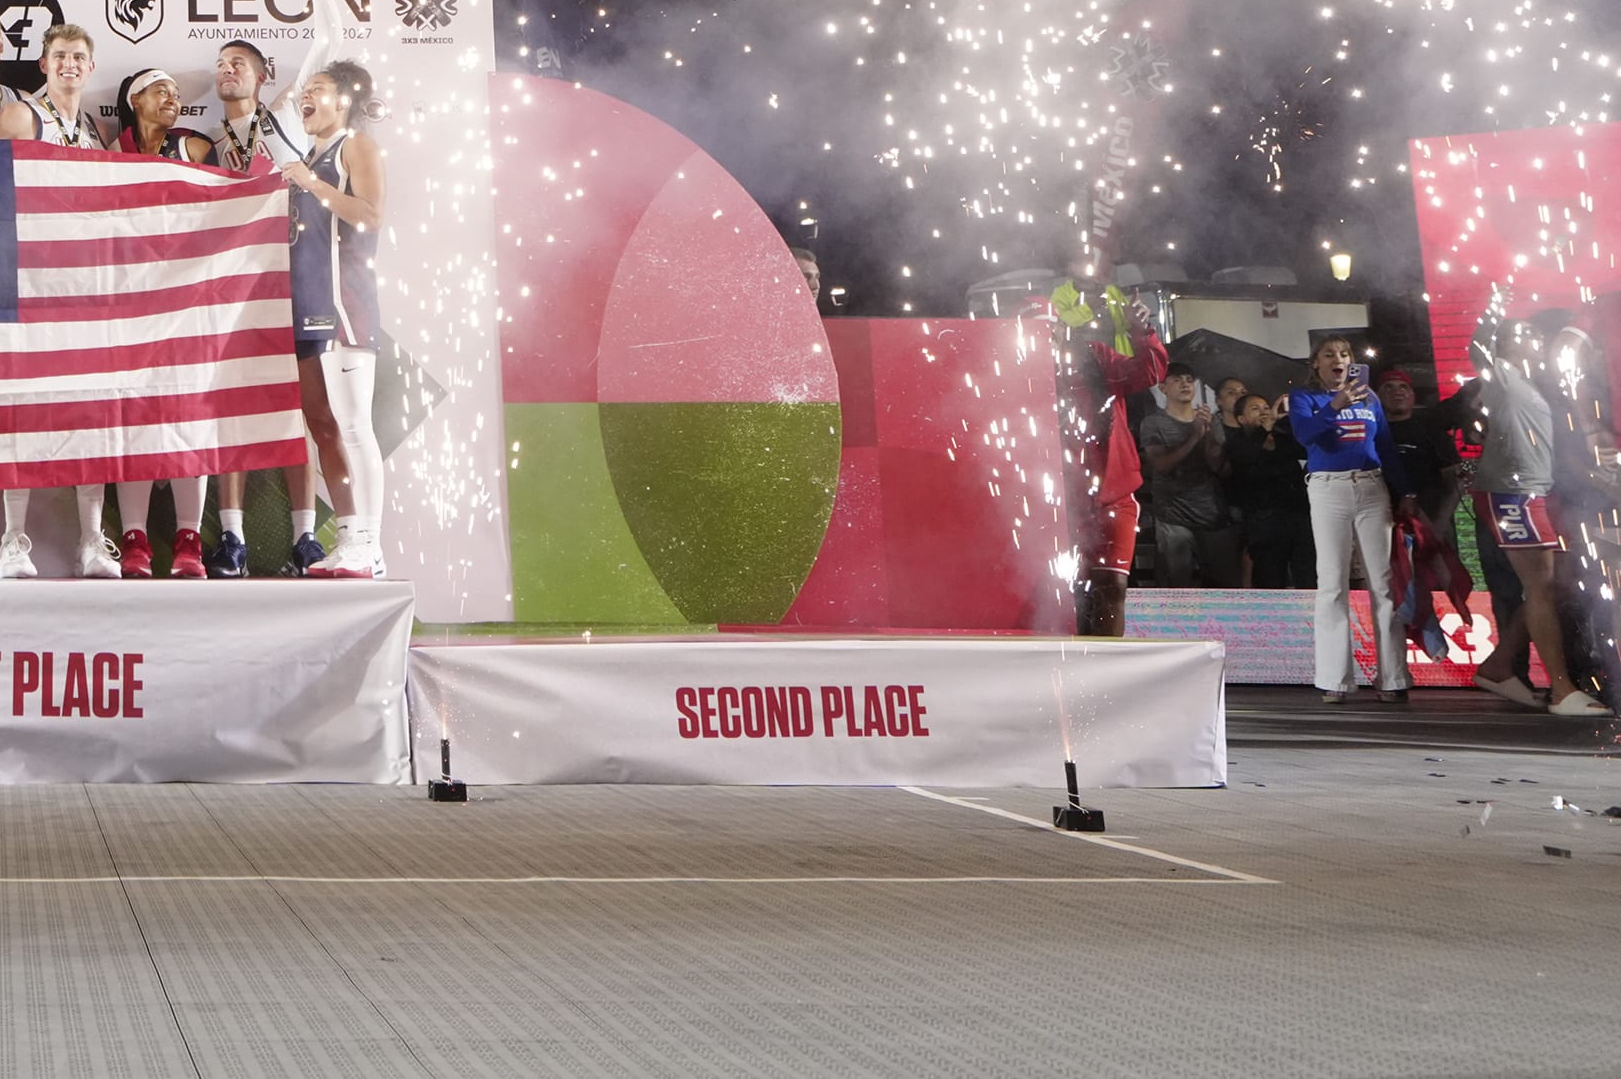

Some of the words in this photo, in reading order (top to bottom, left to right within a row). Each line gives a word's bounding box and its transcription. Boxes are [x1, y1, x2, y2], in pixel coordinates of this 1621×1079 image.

[187, 27, 299, 40] AYUNTAMIENTO
[12, 651, 144, 718] PLACE
[675, 685, 814, 739] SECOND
[820, 684, 930, 737] PLACE
